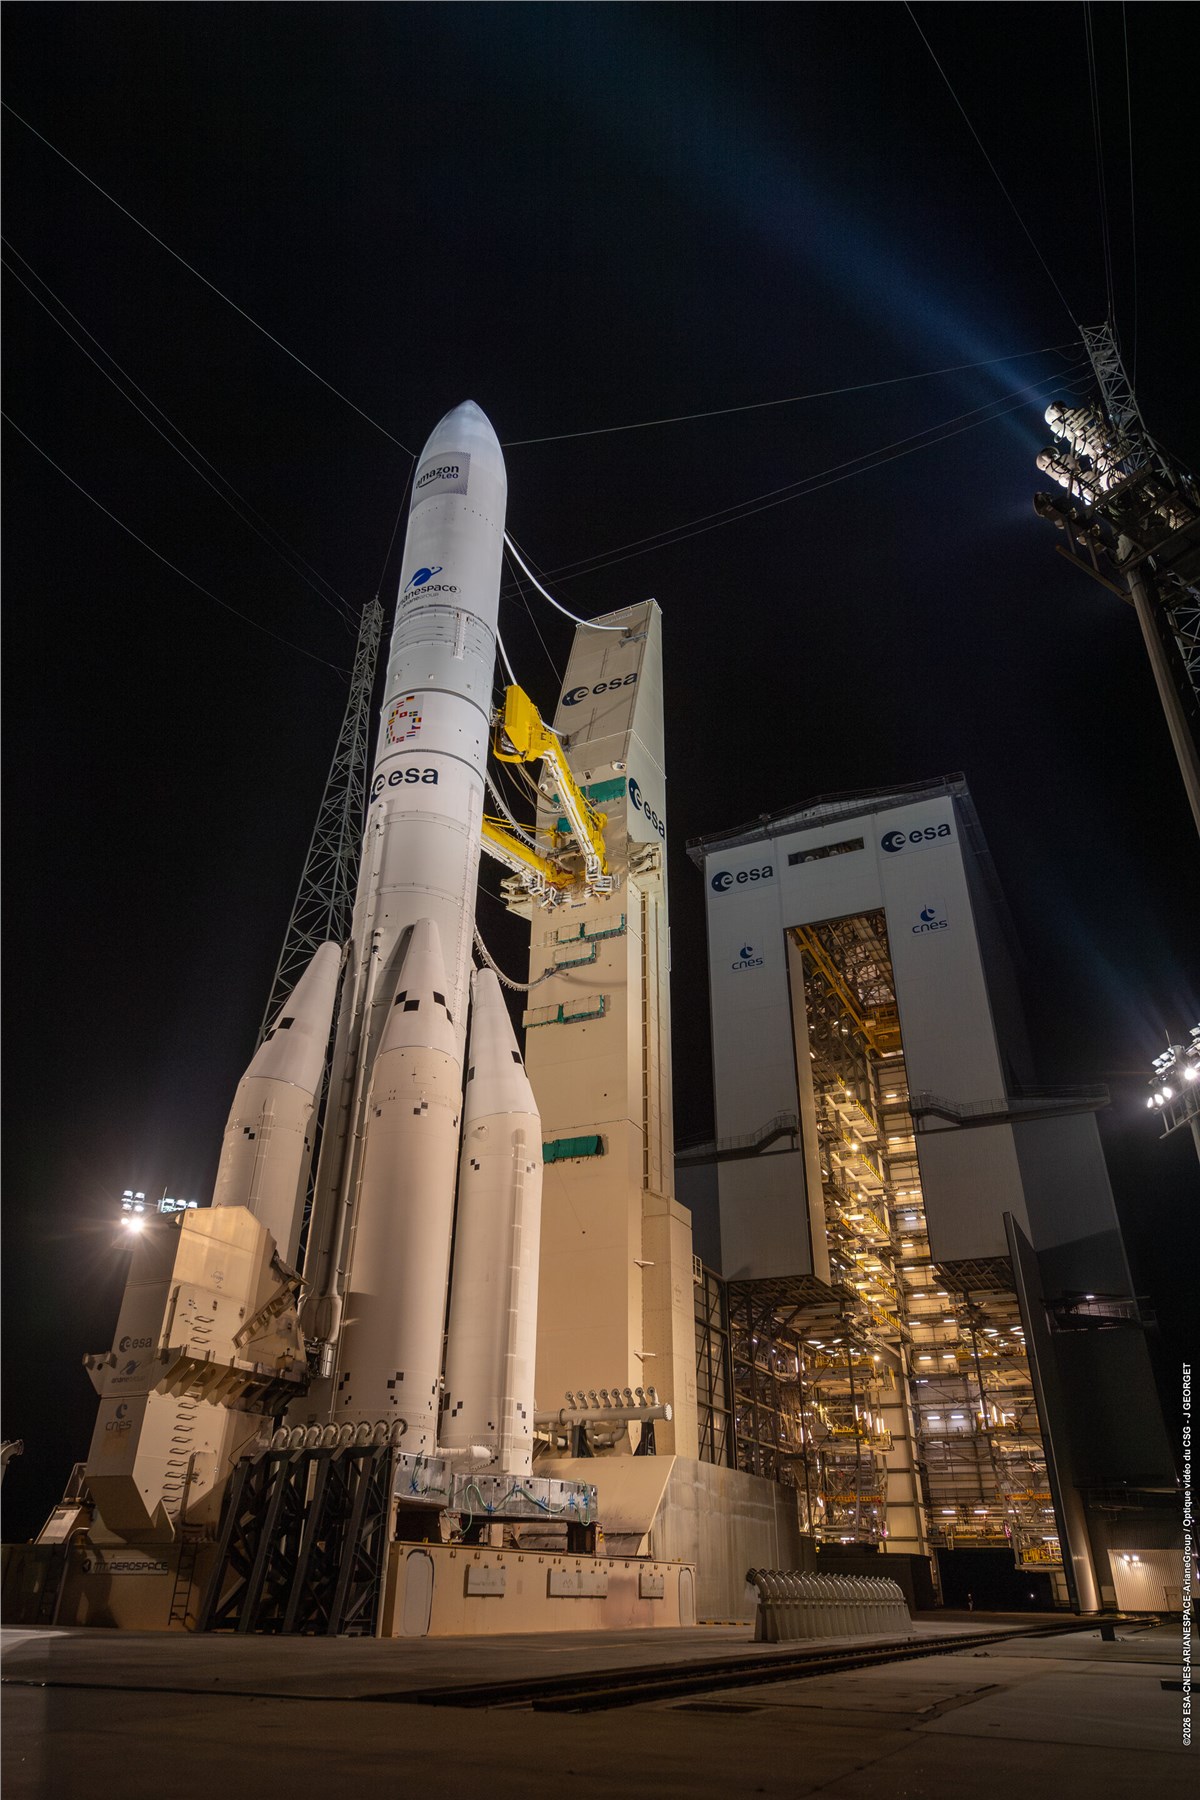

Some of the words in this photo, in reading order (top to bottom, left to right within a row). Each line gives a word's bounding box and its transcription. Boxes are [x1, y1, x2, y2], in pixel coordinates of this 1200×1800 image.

[592, 672, 638, 695] esa
[388, 767, 439, 787] esa
[643, 801, 666, 840] esa
[909, 823, 951, 843] esa
[736, 865, 774, 884] esa
[912, 919, 948, 934] cnes
[731, 956, 764, 970] cnes
[132, 1337, 153, 1349] esa
[105, 1419, 133, 1432] cnes
[109, 1561, 169, 1571] AEROSPACE
